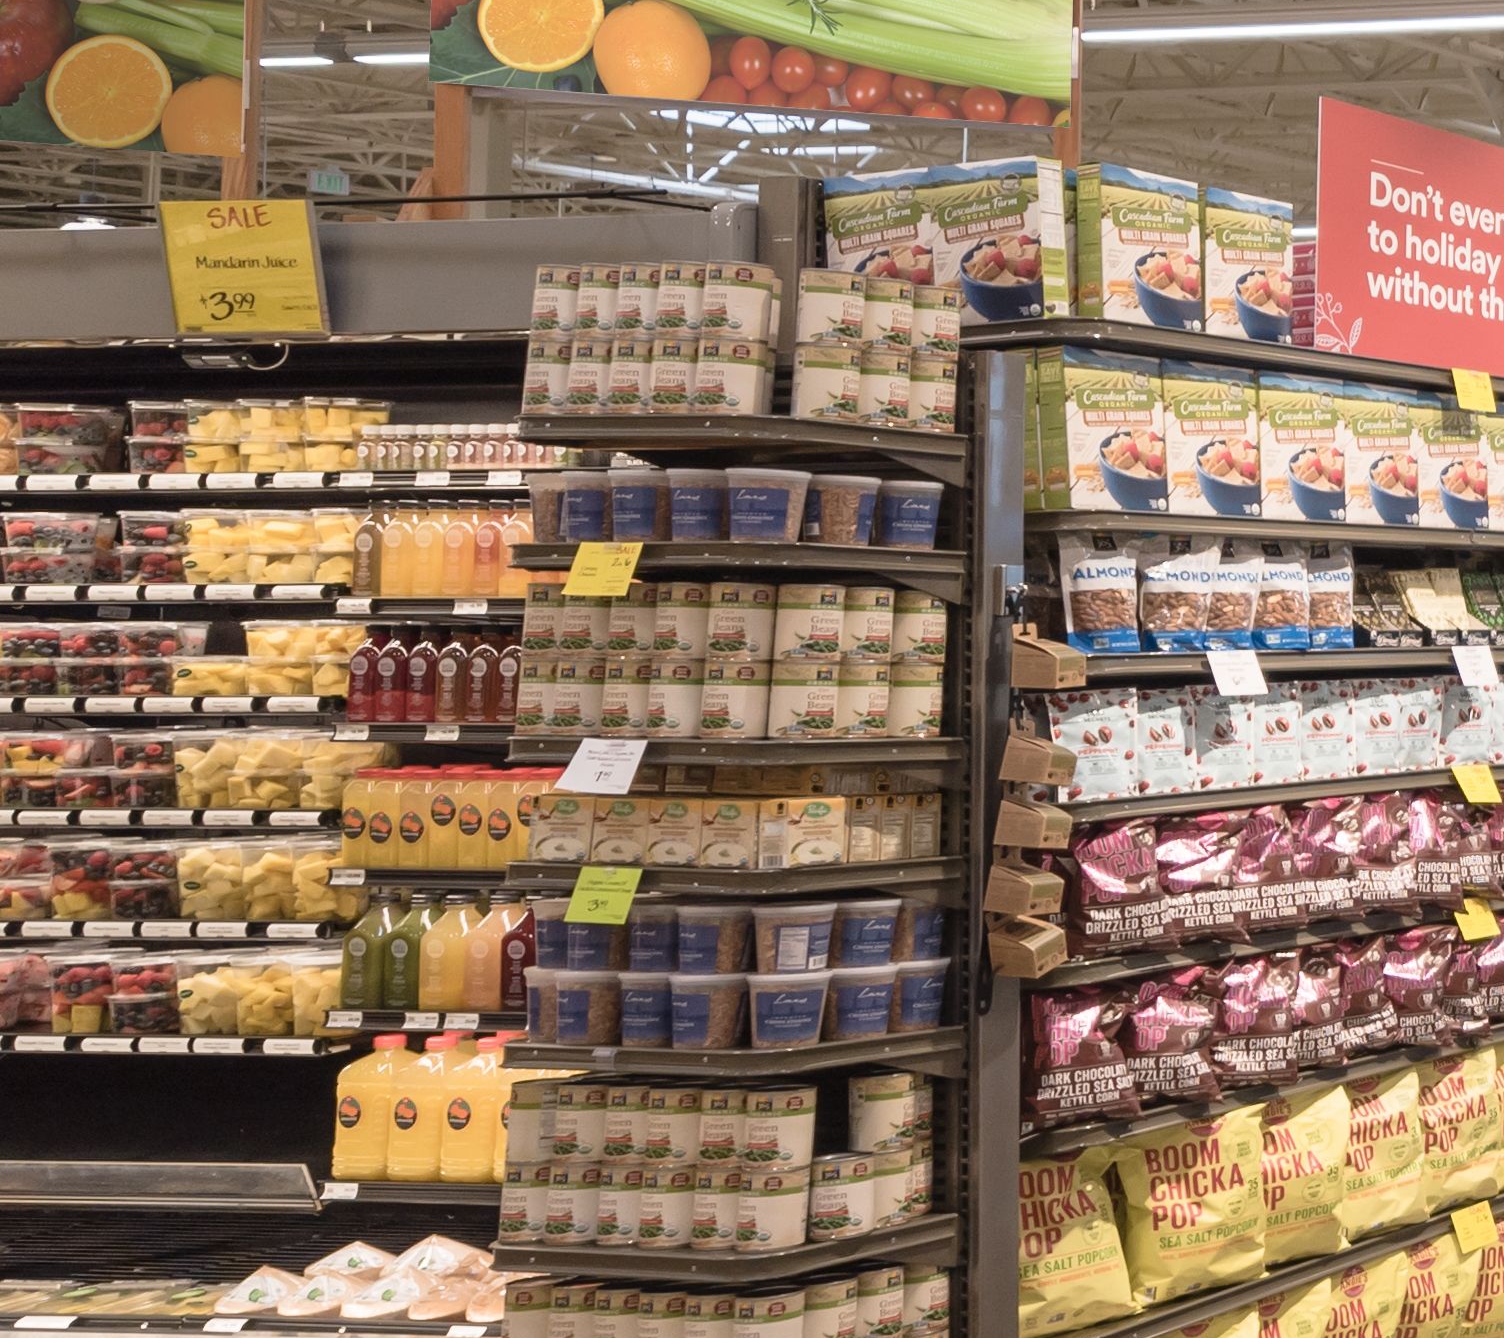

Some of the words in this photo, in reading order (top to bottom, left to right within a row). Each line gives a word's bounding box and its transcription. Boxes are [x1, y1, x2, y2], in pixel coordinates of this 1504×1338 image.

[1370, 171, 1444, 222] Don't
[207, 204, 272, 229] SALE
[196, 256, 259, 270] Mandarin
[262, 256, 298, 269] Juice
[1367, 220, 1398, 255] to
[1405, 224, 1502, 285] holiday
[1367, 266, 1474, 316] without
[1145, 1138, 1220, 1174] BOOM
[1150, 1163, 1244, 1202] CHICKA
[1152, 1202, 1203, 1231] POP
